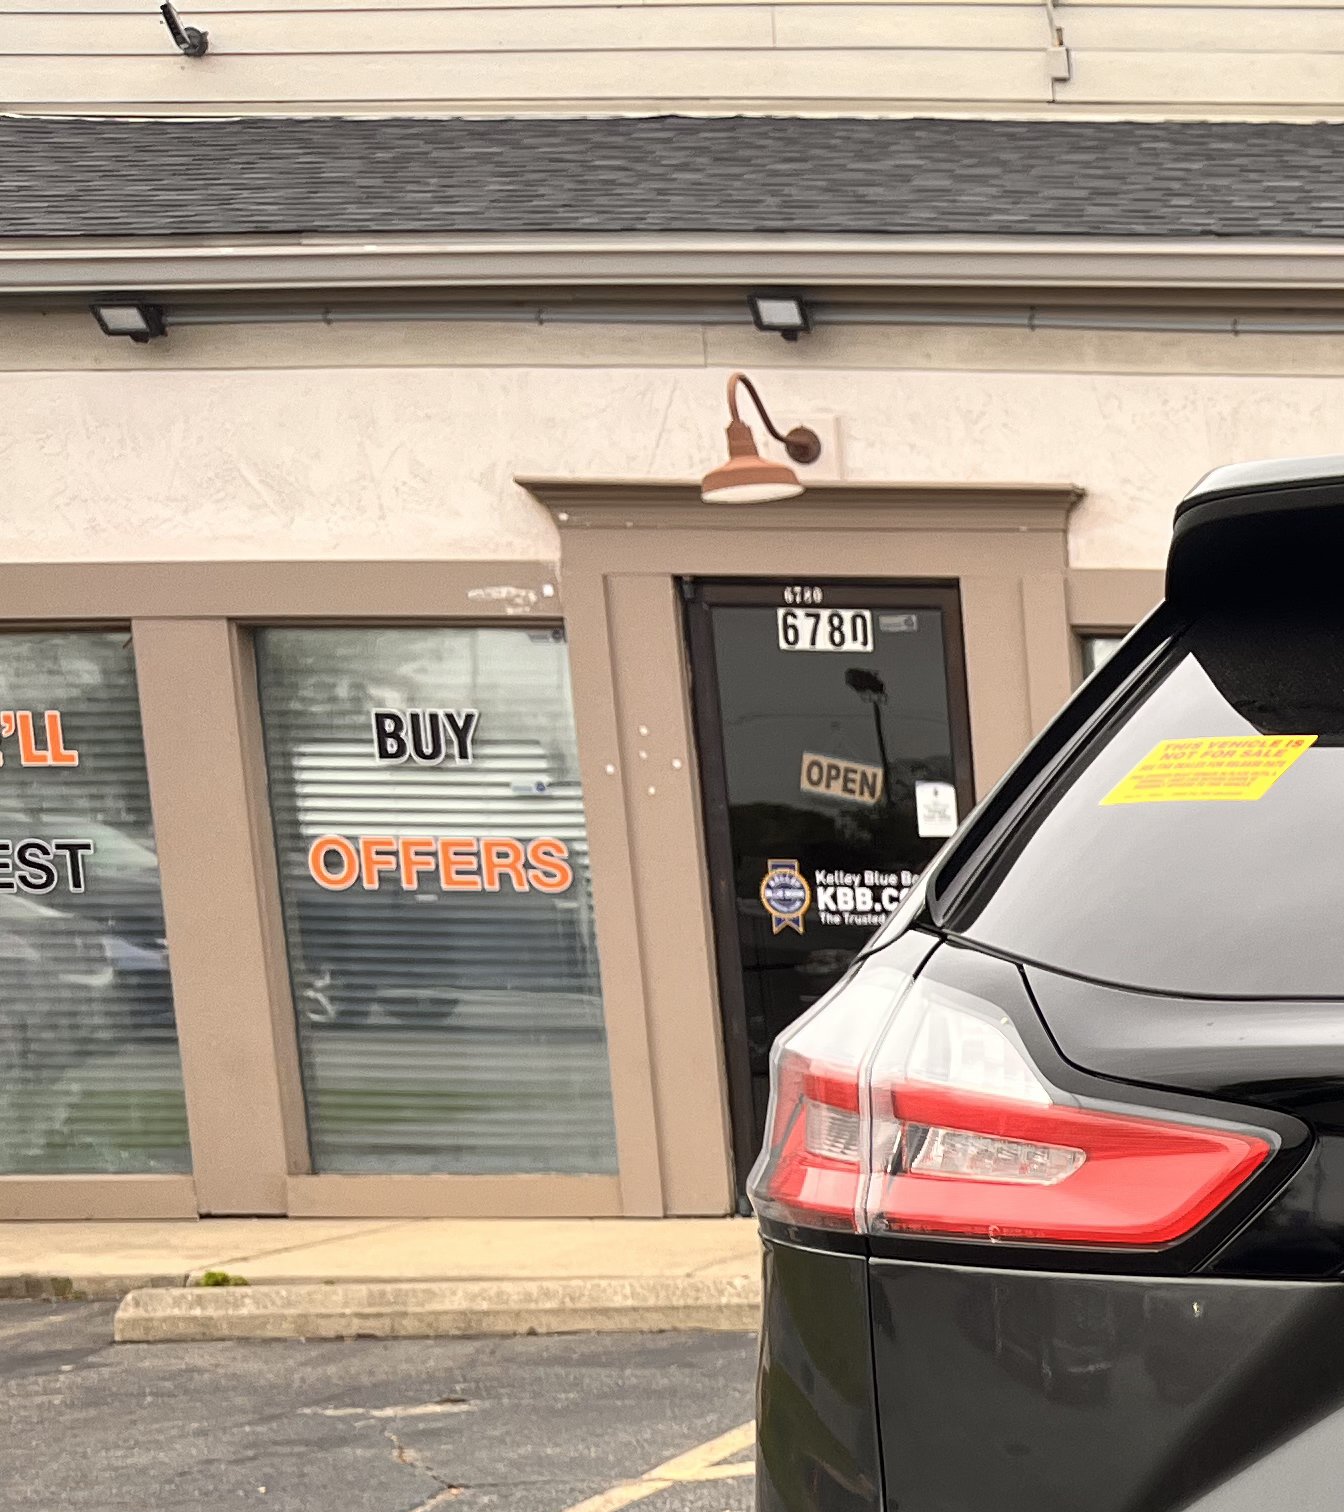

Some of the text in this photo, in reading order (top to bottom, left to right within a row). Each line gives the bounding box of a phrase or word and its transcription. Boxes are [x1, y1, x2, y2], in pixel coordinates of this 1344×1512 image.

[782, 610, 869, 648] 6780
[0, 710, 79, 766] 'LL
[371, 708, 479, 765] BUY
[806, 760, 878, 799] OPEN
[308, 834, 573, 893] OFFERS
[815, 870, 861, 887] Kelley
[864, 871, 898, 886] Blue
[900, 871, 920, 886] Bo
[816, 887, 911, 912] KBB.C
[819, 912, 887, 926] The Trusted
